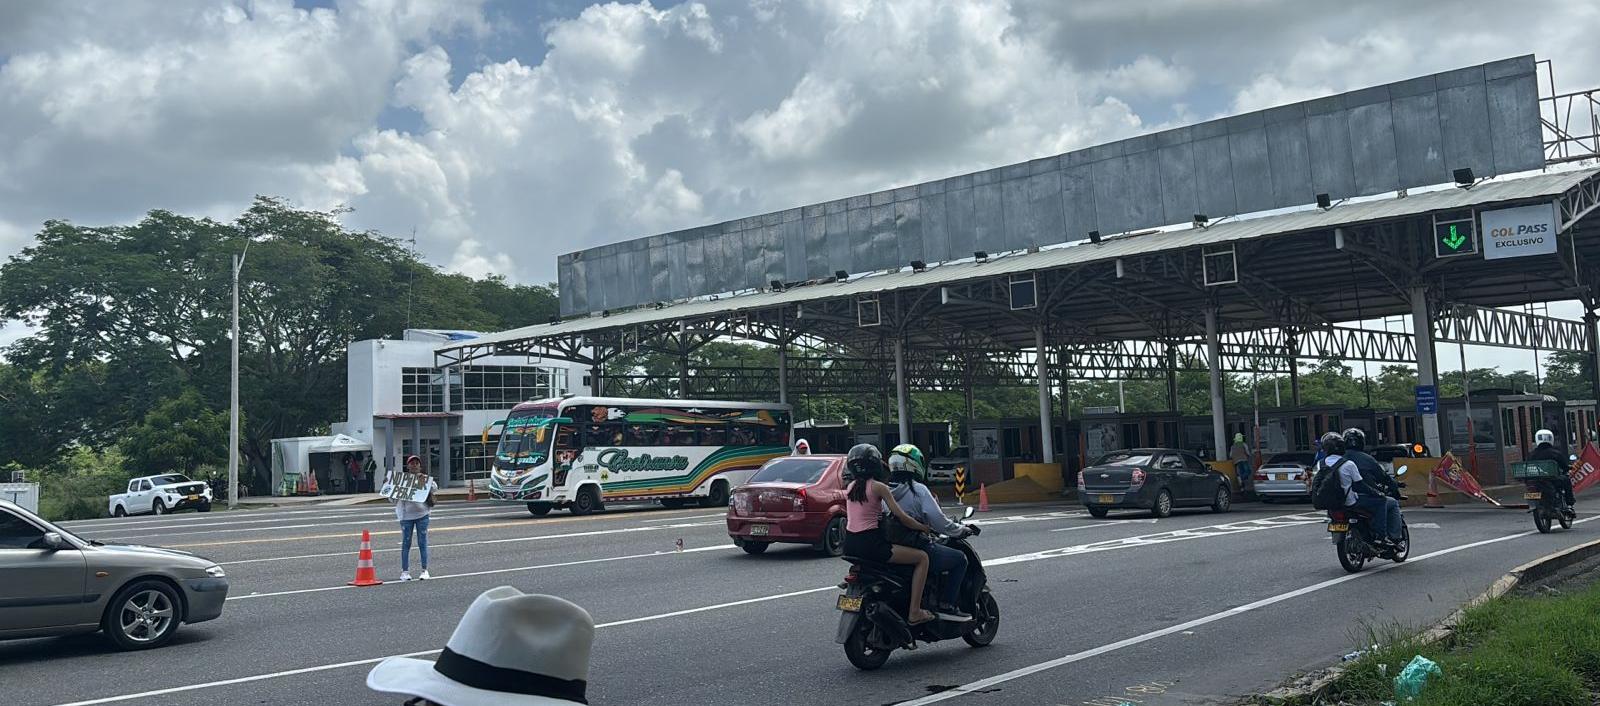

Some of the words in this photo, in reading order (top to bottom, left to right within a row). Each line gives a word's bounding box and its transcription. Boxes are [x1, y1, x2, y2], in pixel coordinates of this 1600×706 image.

[1490, 227, 1514, 238] COL
[1517, 223, 1548, 235] PASS
[1495, 237, 1544, 248] EXCLUSIVO
